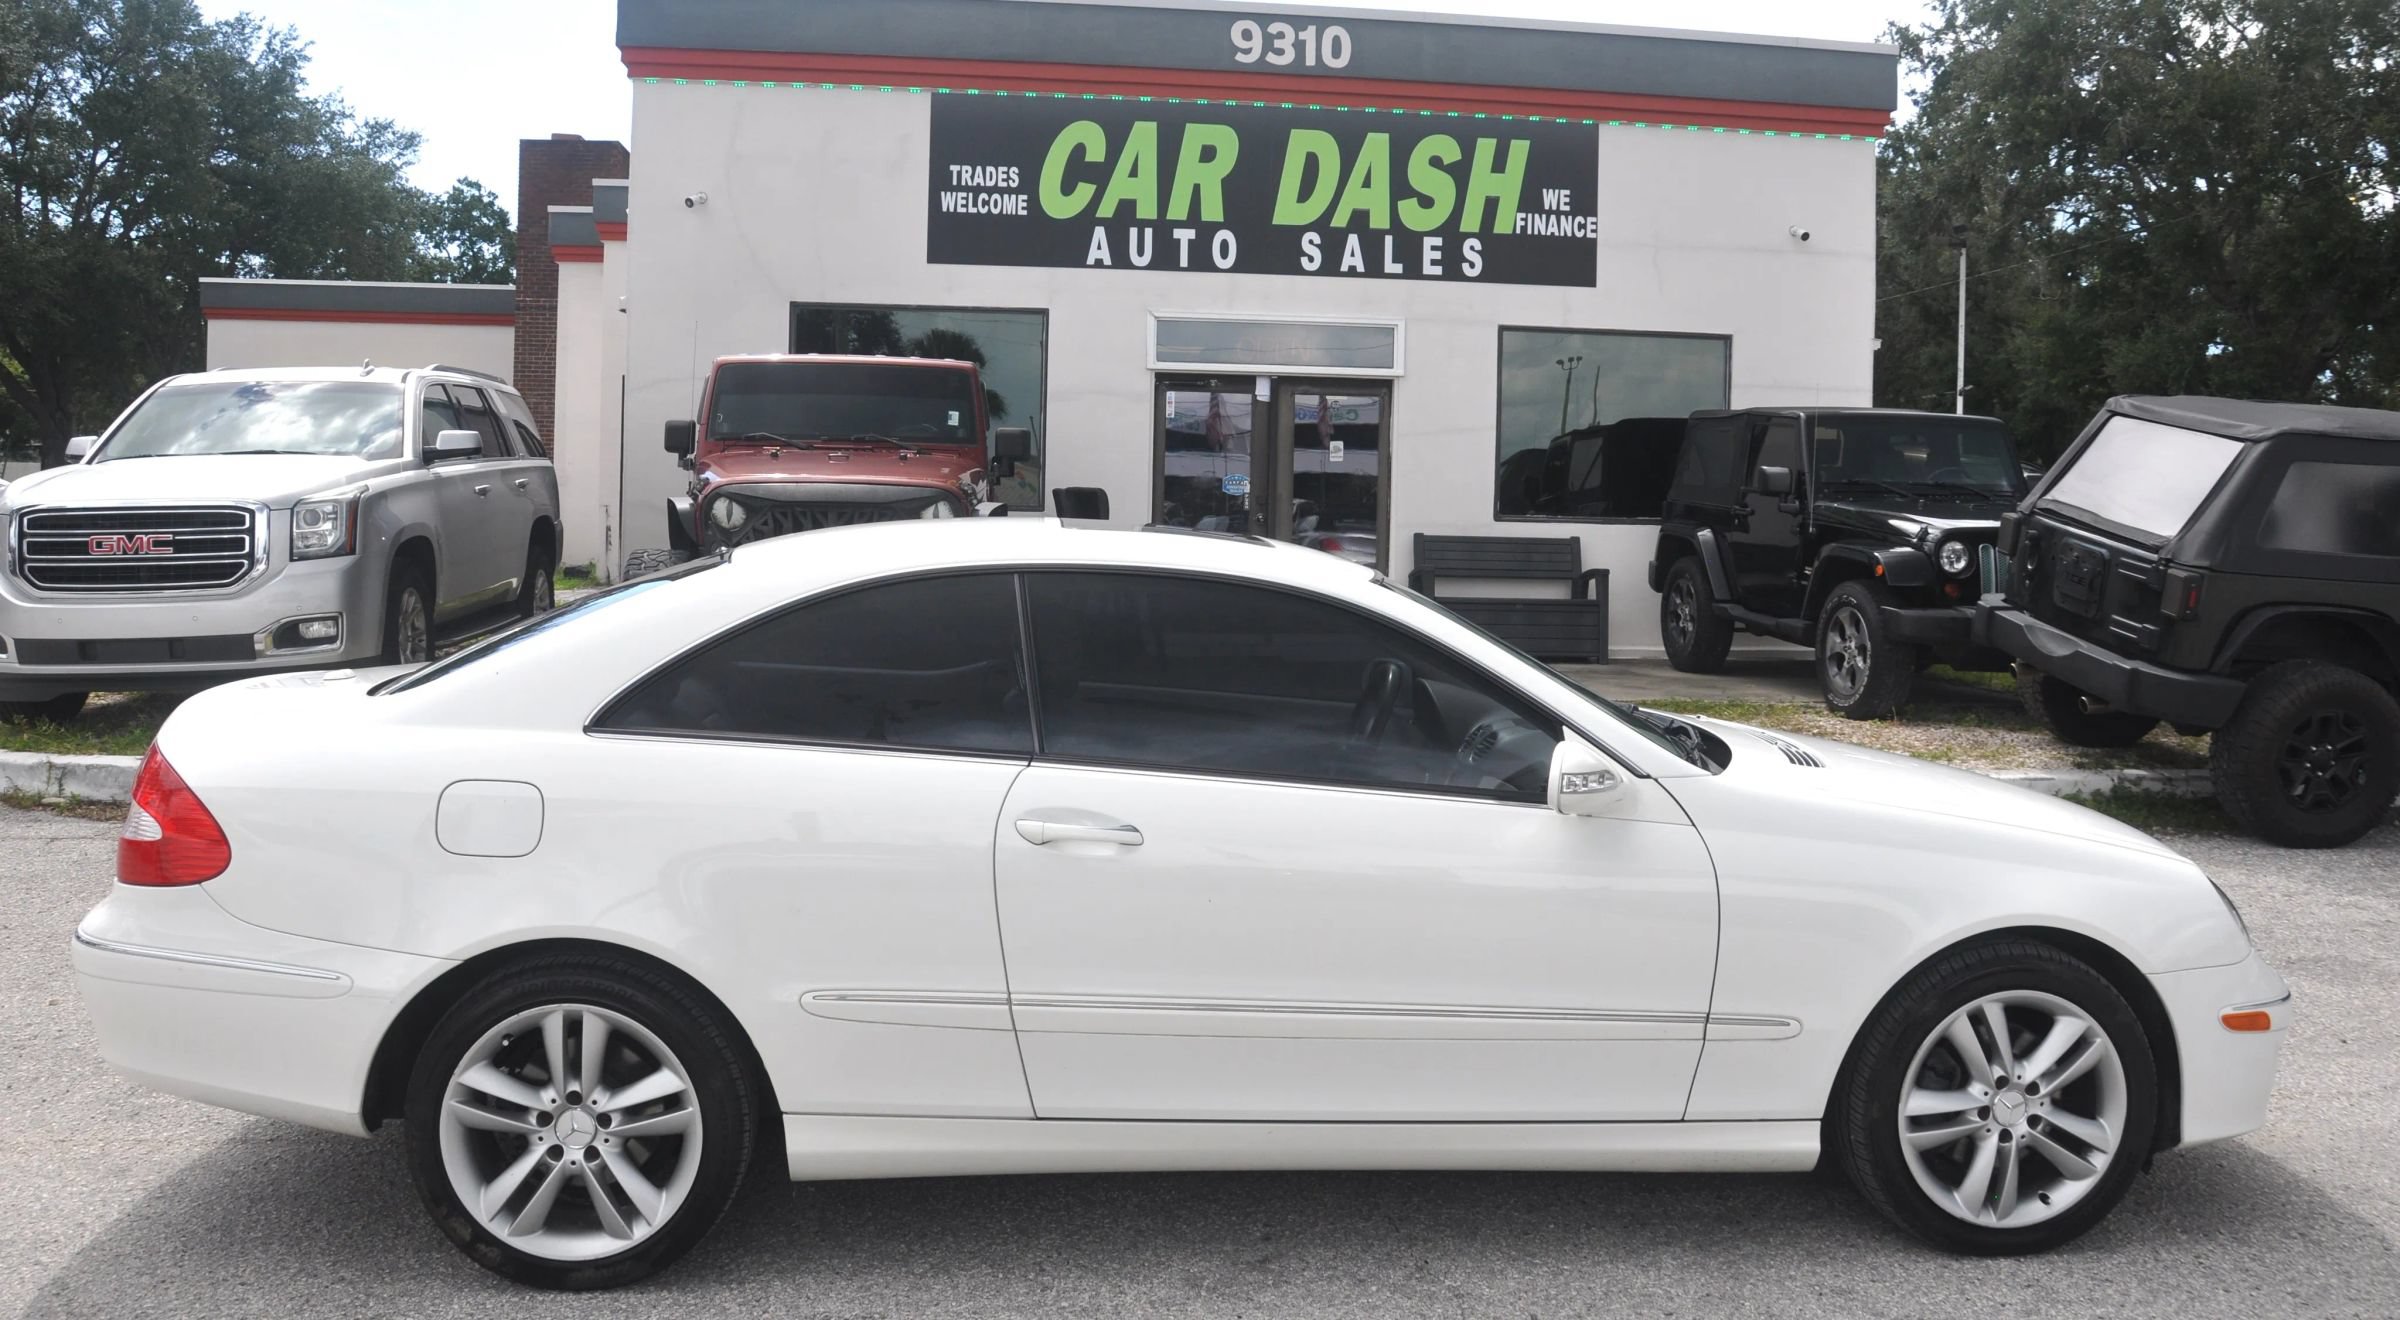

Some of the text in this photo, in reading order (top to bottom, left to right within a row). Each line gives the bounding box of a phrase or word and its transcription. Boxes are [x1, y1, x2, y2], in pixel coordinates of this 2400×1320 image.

[1230, 19, 1352, 69] 9310
[949, 164, 1020, 188] TRADES
[1039, 120, 1531, 234] CAR DASH
[940, 190, 1028, 216] WELCOME
[1542, 187, 1571, 212] WE
[1515, 211, 1598, 239] FINANCE
[1085, 225, 1483, 278] AUTO SALES
[88, 534, 174, 555] GMC
